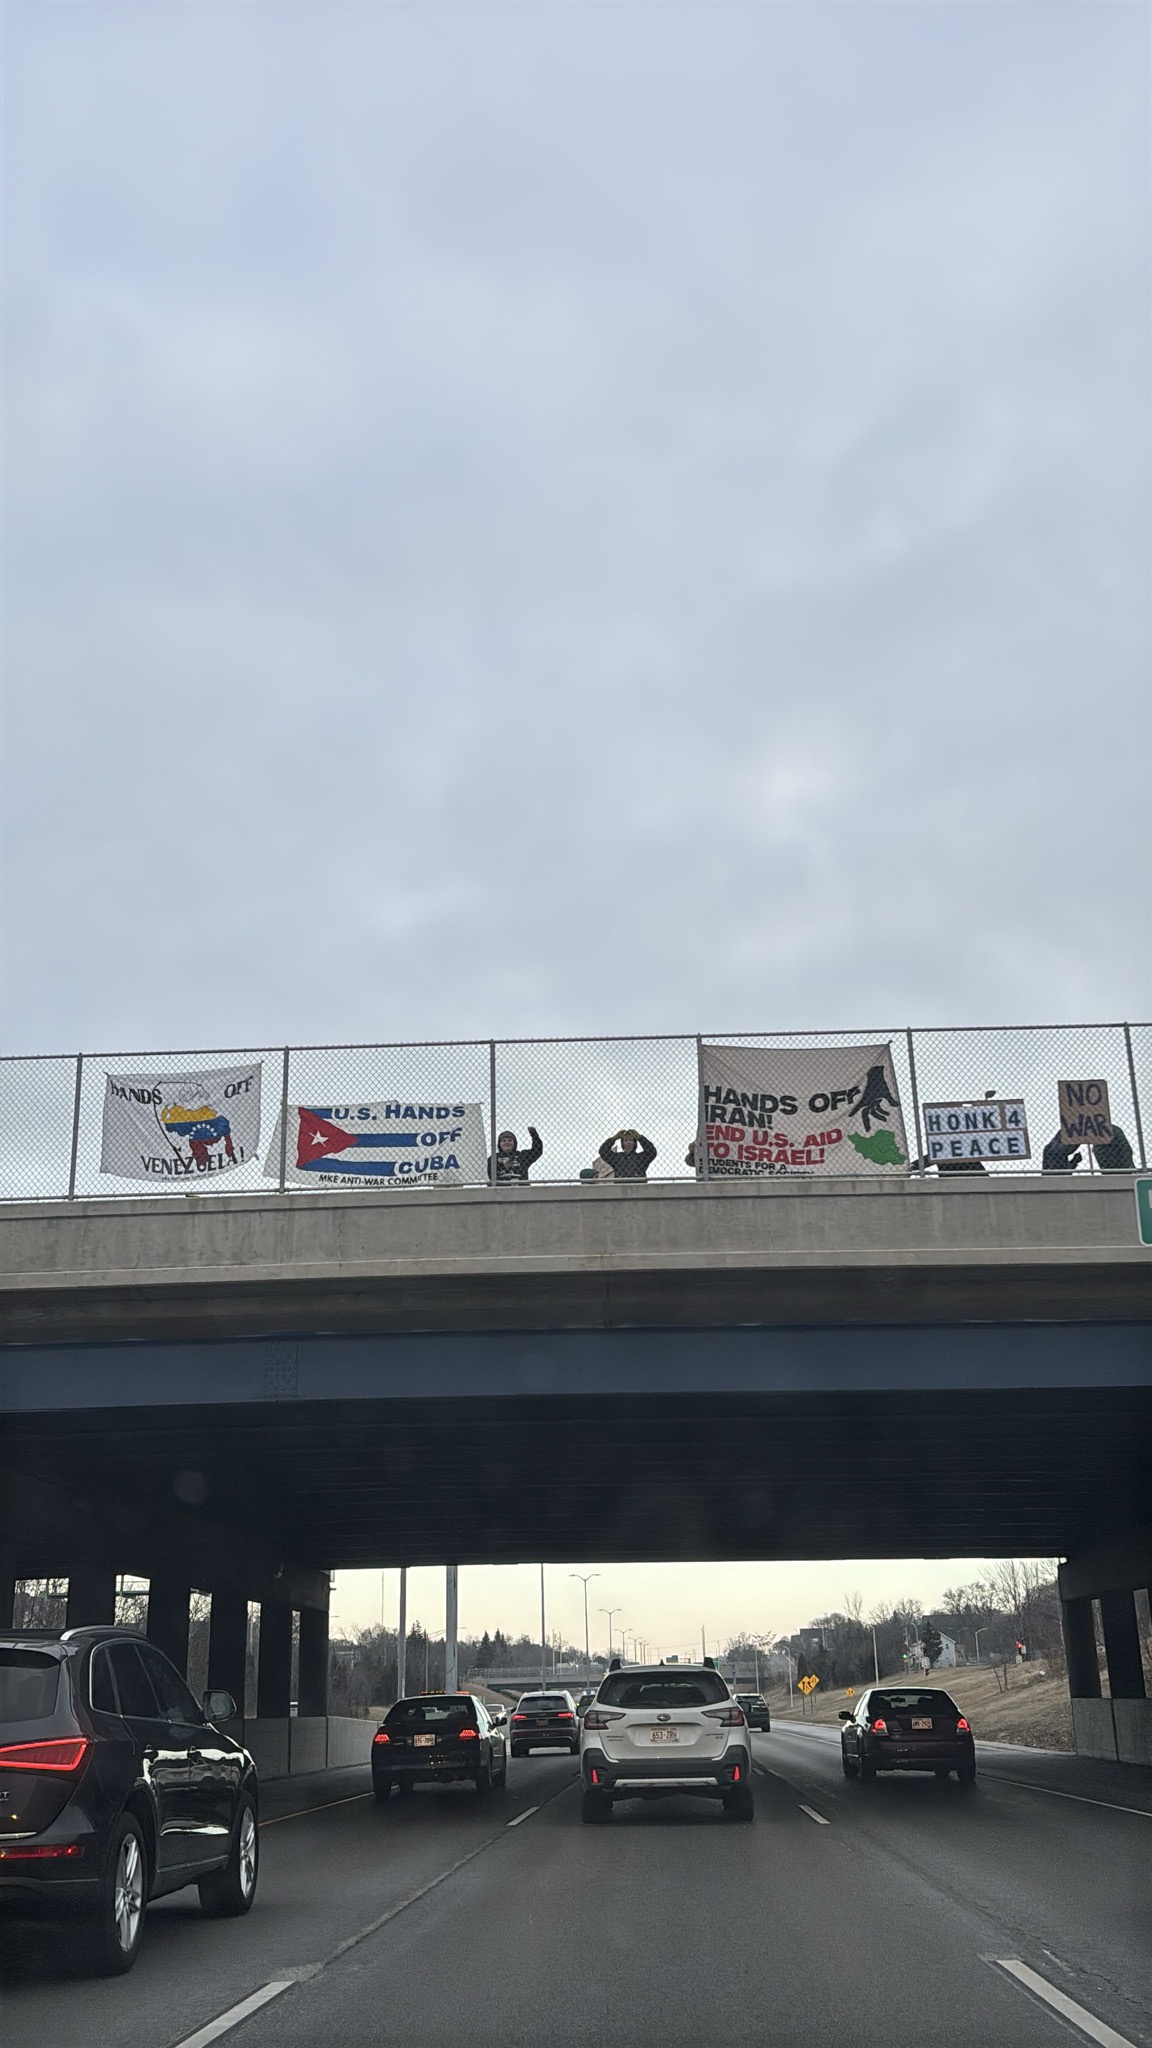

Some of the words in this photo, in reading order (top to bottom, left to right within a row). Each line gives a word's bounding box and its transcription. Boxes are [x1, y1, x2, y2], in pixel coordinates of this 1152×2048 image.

[109, 1080, 163, 1105] HANDS
[224, 1075, 254, 1098] OFF
[704, 1085, 798, 1115] HANDS
[808, 1086, 861, 1113] OFF
[1066, 1083, 1102, 1107] NO
[334, 1107, 377, 1121] U.S.
[385, 1104, 466, 1119] HANDS
[928, 1112, 997, 1132] HONK
[1008, 1110, 1022, 1127] 4
[705, 1124, 745, 1142] END
[752, 1130, 795, 1148] U.S.
[803, 1128, 843, 1148] AID
[1061, 1113, 1111, 1138] WAR
[420, 1127, 463, 1147] OFF
[931, 1137, 1021, 1158] PEACE
[398, 1154, 460, 1175] CUBA
[738, 1146, 825, 1166] ISRAEL!
[755, 1162, 776, 1171] FOR
[318, 1174, 339, 1184] MKE
[341, 1175, 385, 1186] ANTI-WAR
[387, 1173, 439, 1186] COMMITTEE
